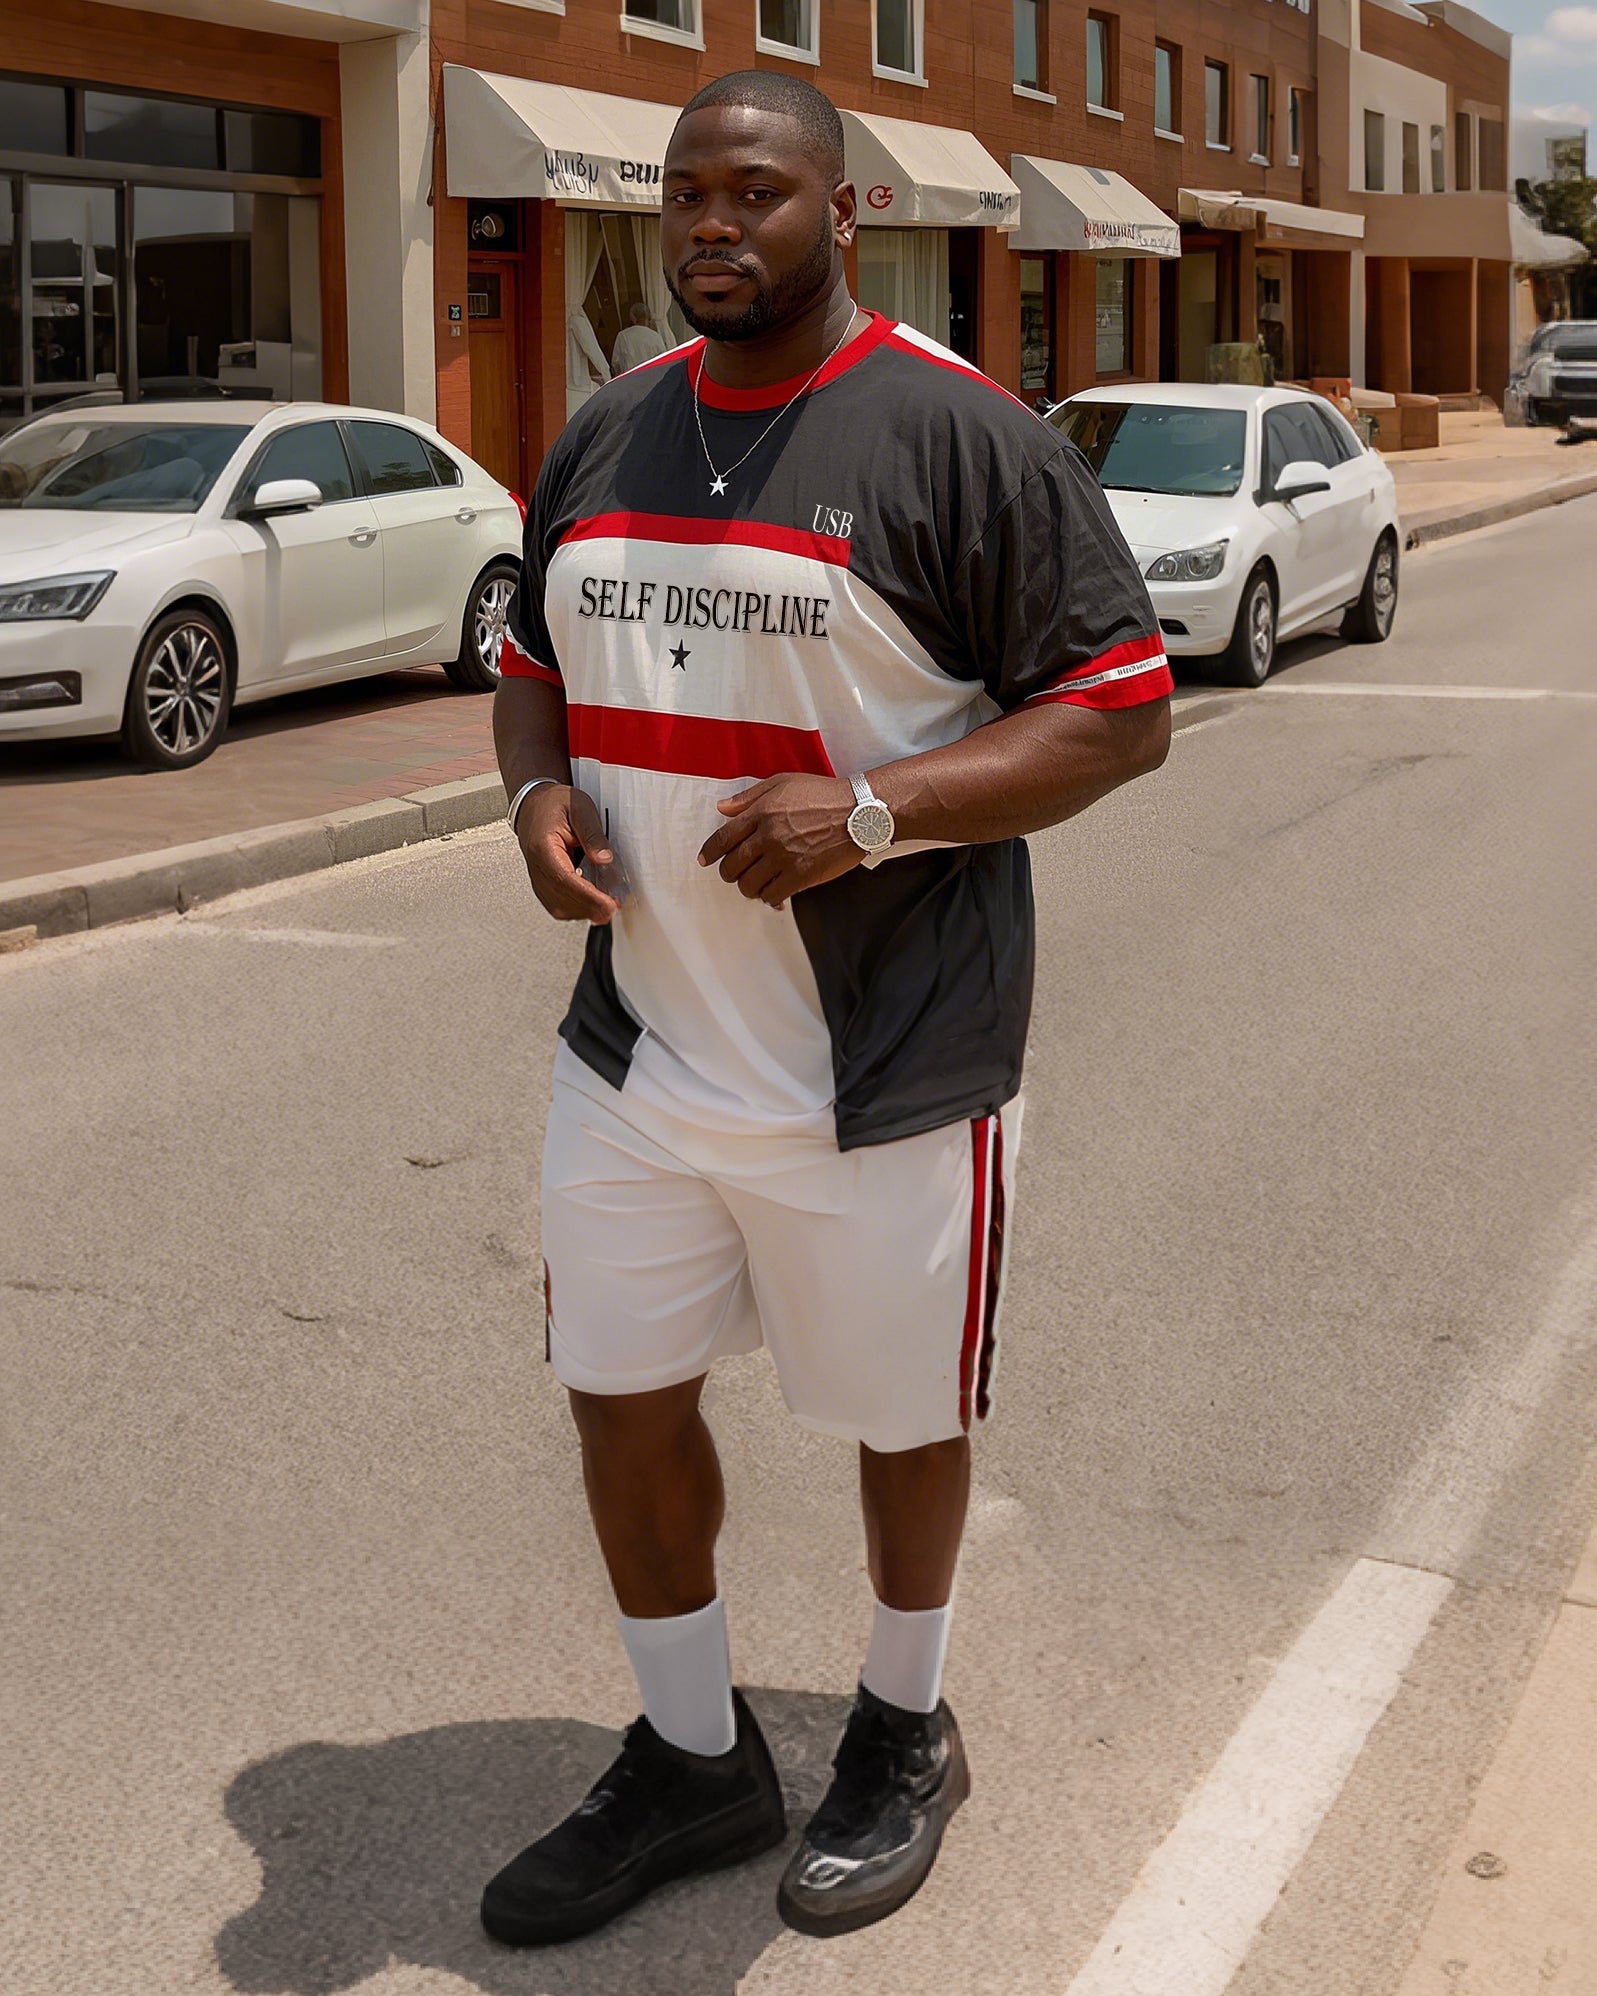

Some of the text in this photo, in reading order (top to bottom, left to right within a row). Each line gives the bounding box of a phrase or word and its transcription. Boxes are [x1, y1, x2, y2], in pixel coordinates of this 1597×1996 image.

[812, 503, 854, 539] USB
[578, 576, 831, 640] SELF DISCIPLINE
